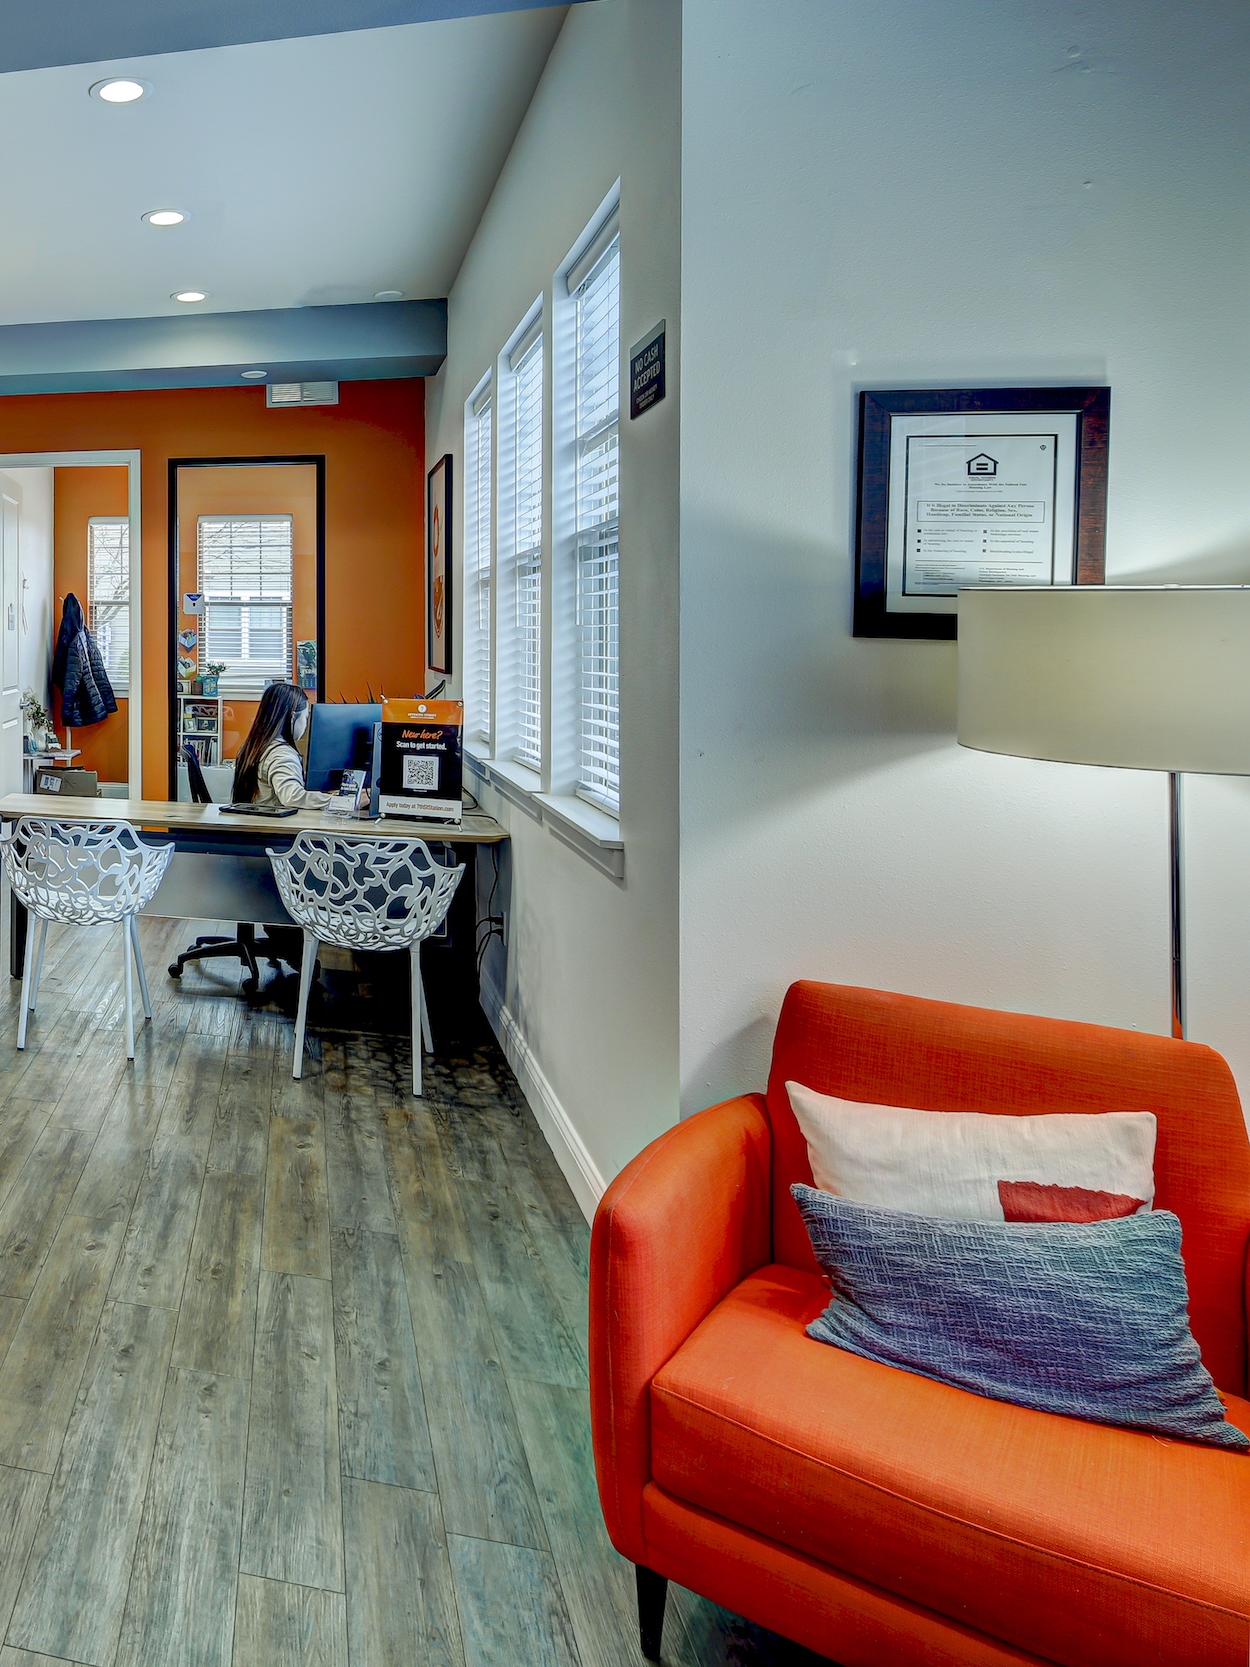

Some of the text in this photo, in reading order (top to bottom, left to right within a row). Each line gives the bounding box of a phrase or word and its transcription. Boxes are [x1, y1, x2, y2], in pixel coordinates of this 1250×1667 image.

[635, 344, 658, 374] NO CASH
[633, 361, 660, 393] ACCEPTED
[402, 729, 443, 740] New here?
[396, 740, 410, 748] Scan
[416, 742, 425, 750] get
